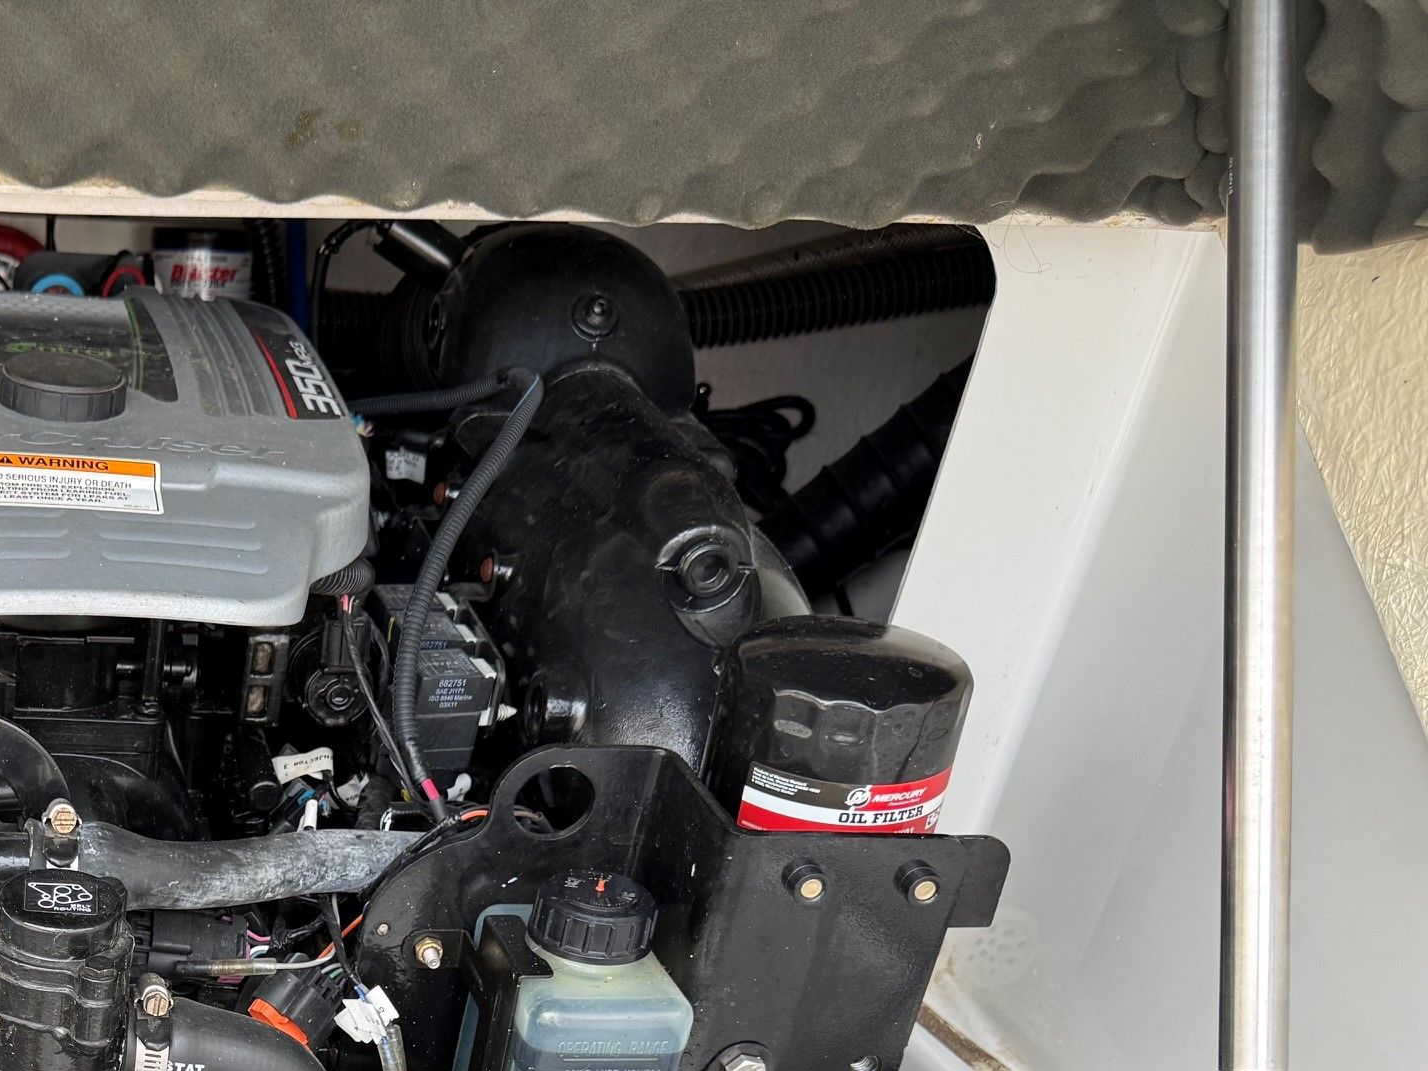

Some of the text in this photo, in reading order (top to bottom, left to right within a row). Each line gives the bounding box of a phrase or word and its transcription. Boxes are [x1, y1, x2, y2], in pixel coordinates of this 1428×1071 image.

[285, 359, 342, 416] 350
[18, 456, 109, 471] WARNING
[5, 473, 47, 482] SERIOUS
[49, 476, 83, 485] INJURY
[85, 478, 99, 487] OR
[101, 480, 132, 489] DEATH
[872, 787, 927, 803] MERCURY
[838, 812, 867, 824] OIL
[871, 805, 924, 824] FILTER
[53, 905, 92, 913] ROUTING
[557, 1041, 669, 1056] OPERATING RANGE
